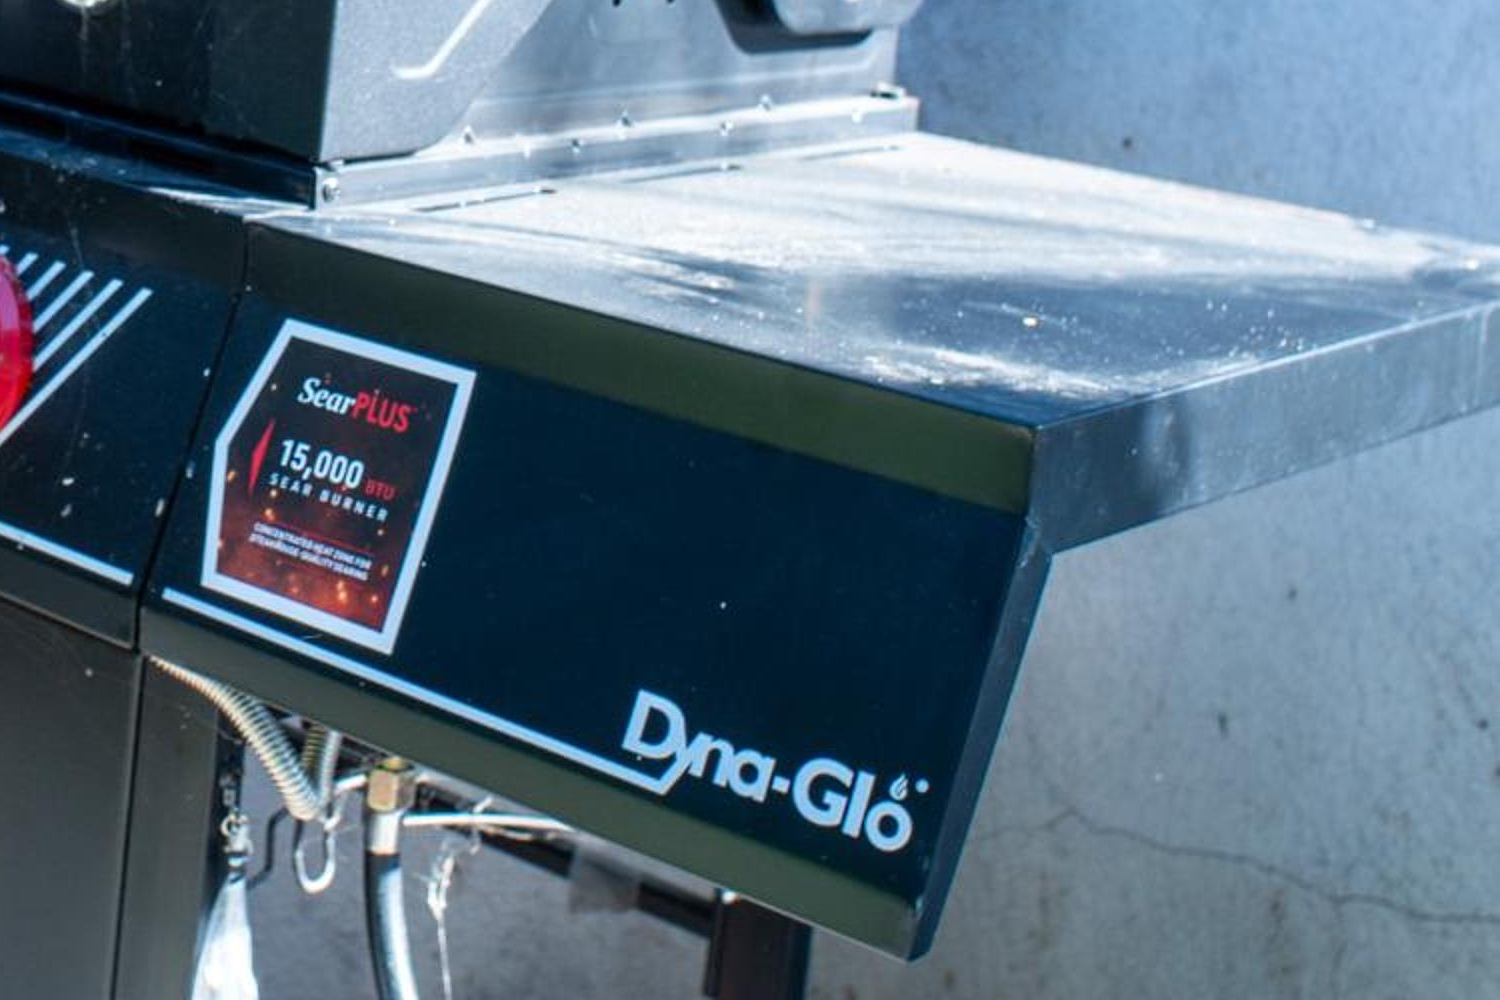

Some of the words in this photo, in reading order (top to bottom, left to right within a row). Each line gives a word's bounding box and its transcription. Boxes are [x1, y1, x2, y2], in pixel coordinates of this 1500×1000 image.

[278, 439, 365, 489] 15,000
[268, 472, 312, 496] SEAR
[319, 489, 389, 522] BURNER
[621, 689, 913, 853] Dyna-Glo
